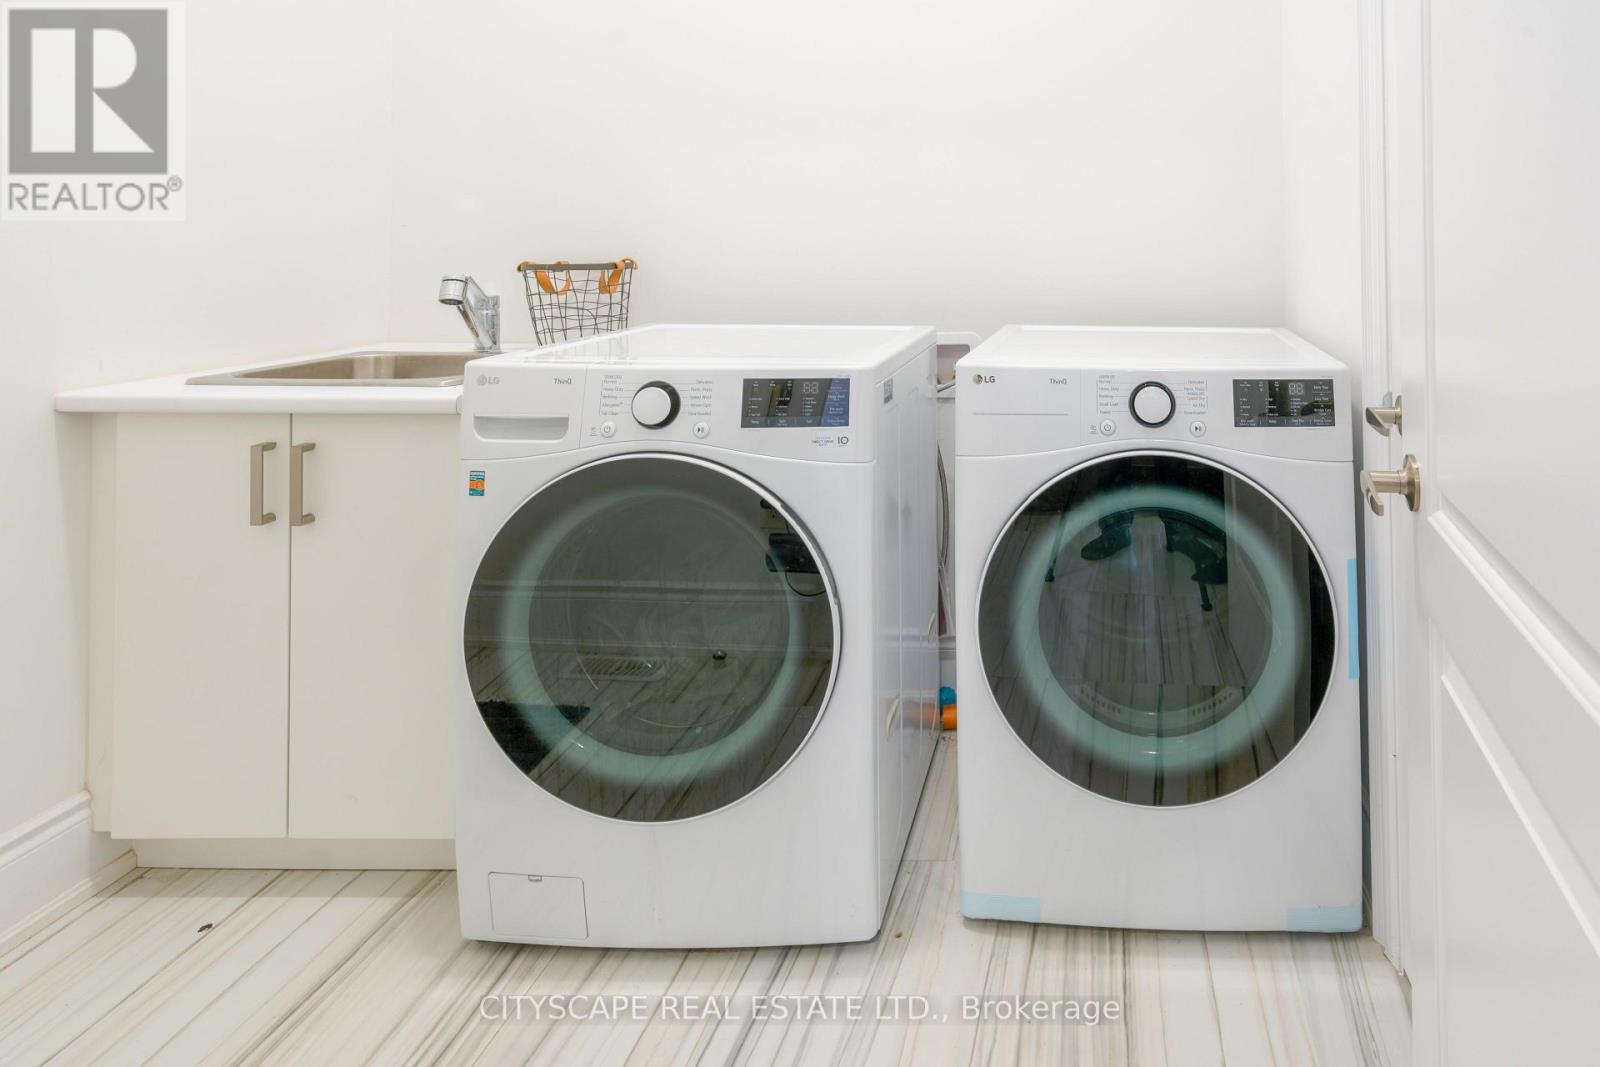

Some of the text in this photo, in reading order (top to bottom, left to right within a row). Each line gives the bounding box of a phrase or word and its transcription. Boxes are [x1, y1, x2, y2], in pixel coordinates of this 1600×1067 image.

[488, 376, 500, 385] LG
[553, 376, 572, 385] ThinQ
[984, 375, 996, 384] LG
[1048, 377, 1068, 385] ThinQ
